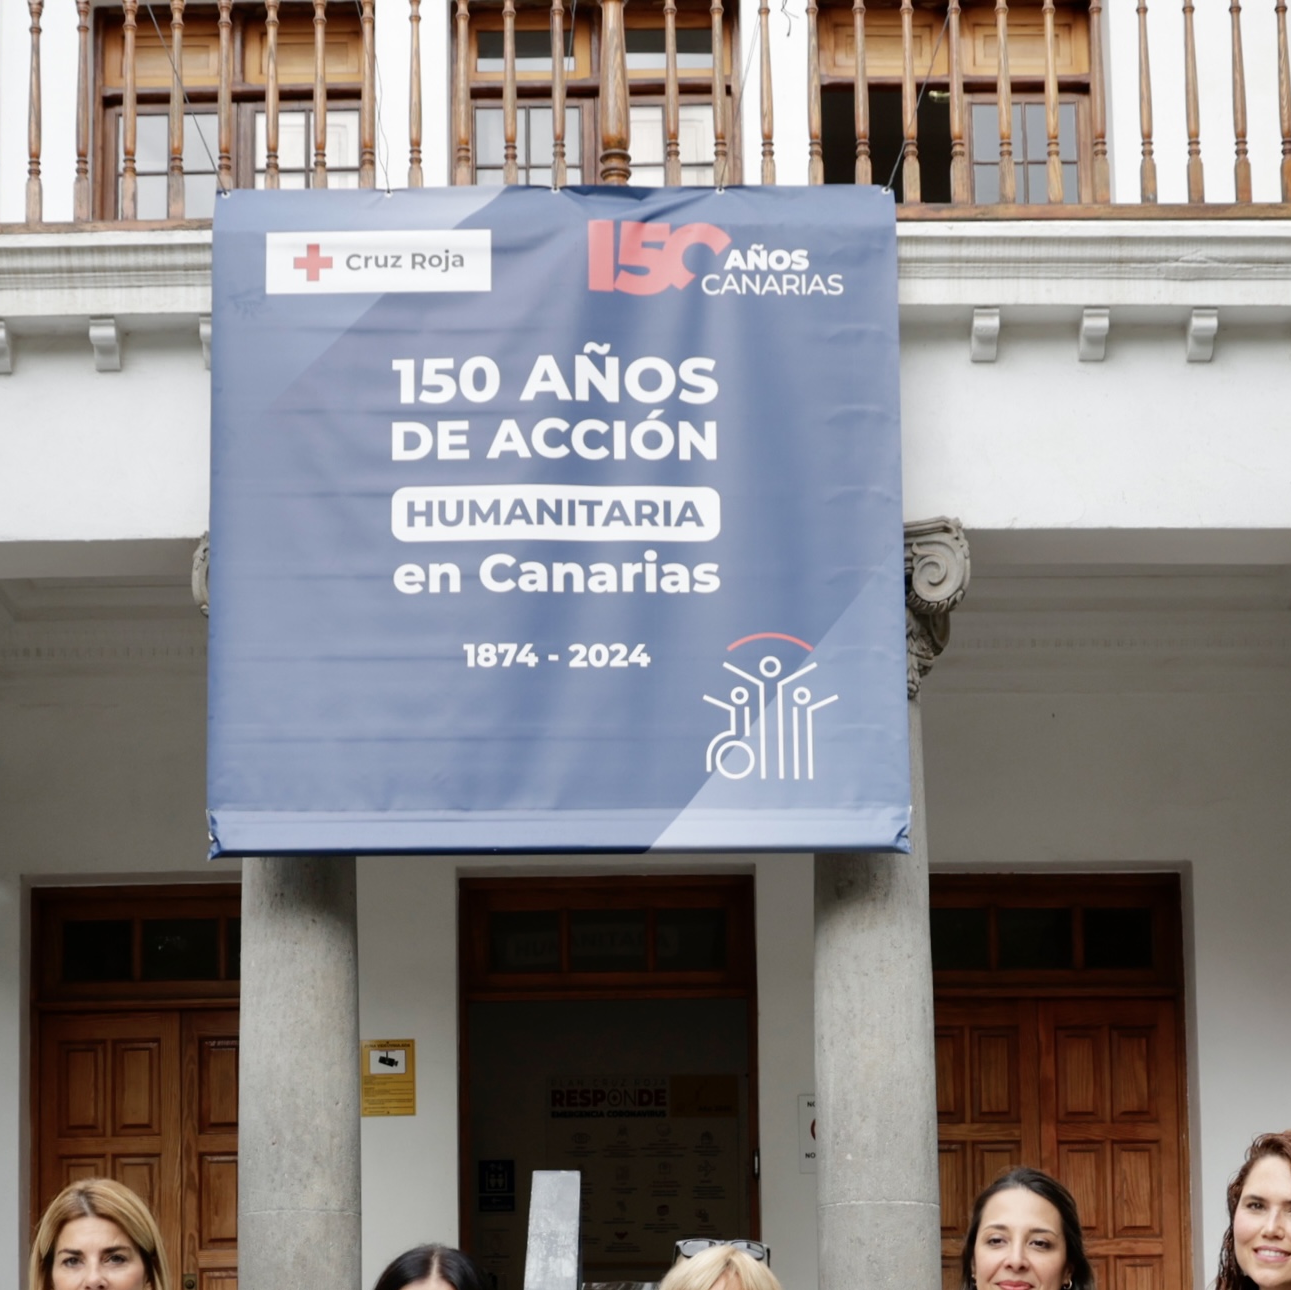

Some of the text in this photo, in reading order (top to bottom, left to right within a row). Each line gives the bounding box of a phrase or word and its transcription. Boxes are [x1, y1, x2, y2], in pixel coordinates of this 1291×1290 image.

[345, 249, 465, 273] Cruz Roja
[723, 244, 809, 271] AÑOS
[701, 273, 844, 296] CANARIAS
[392, 341, 719, 404] 150 AÑOS
[392, 409, 717, 461] DE ACCIÓN
[406, 498, 705, 528] HUMANITARIA
[393, 549, 721, 594] en Canarias
[463, 643, 539, 668] 1874
[568, 643, 651, 668] 2024
[550, 1078, 667, 1087] PLAN CRUZ ROJA
[550, 1088, 667, 1107] RESPONDE
[550, 1110, 667, 1118] EMERGENCIA CORONAVIRUS
